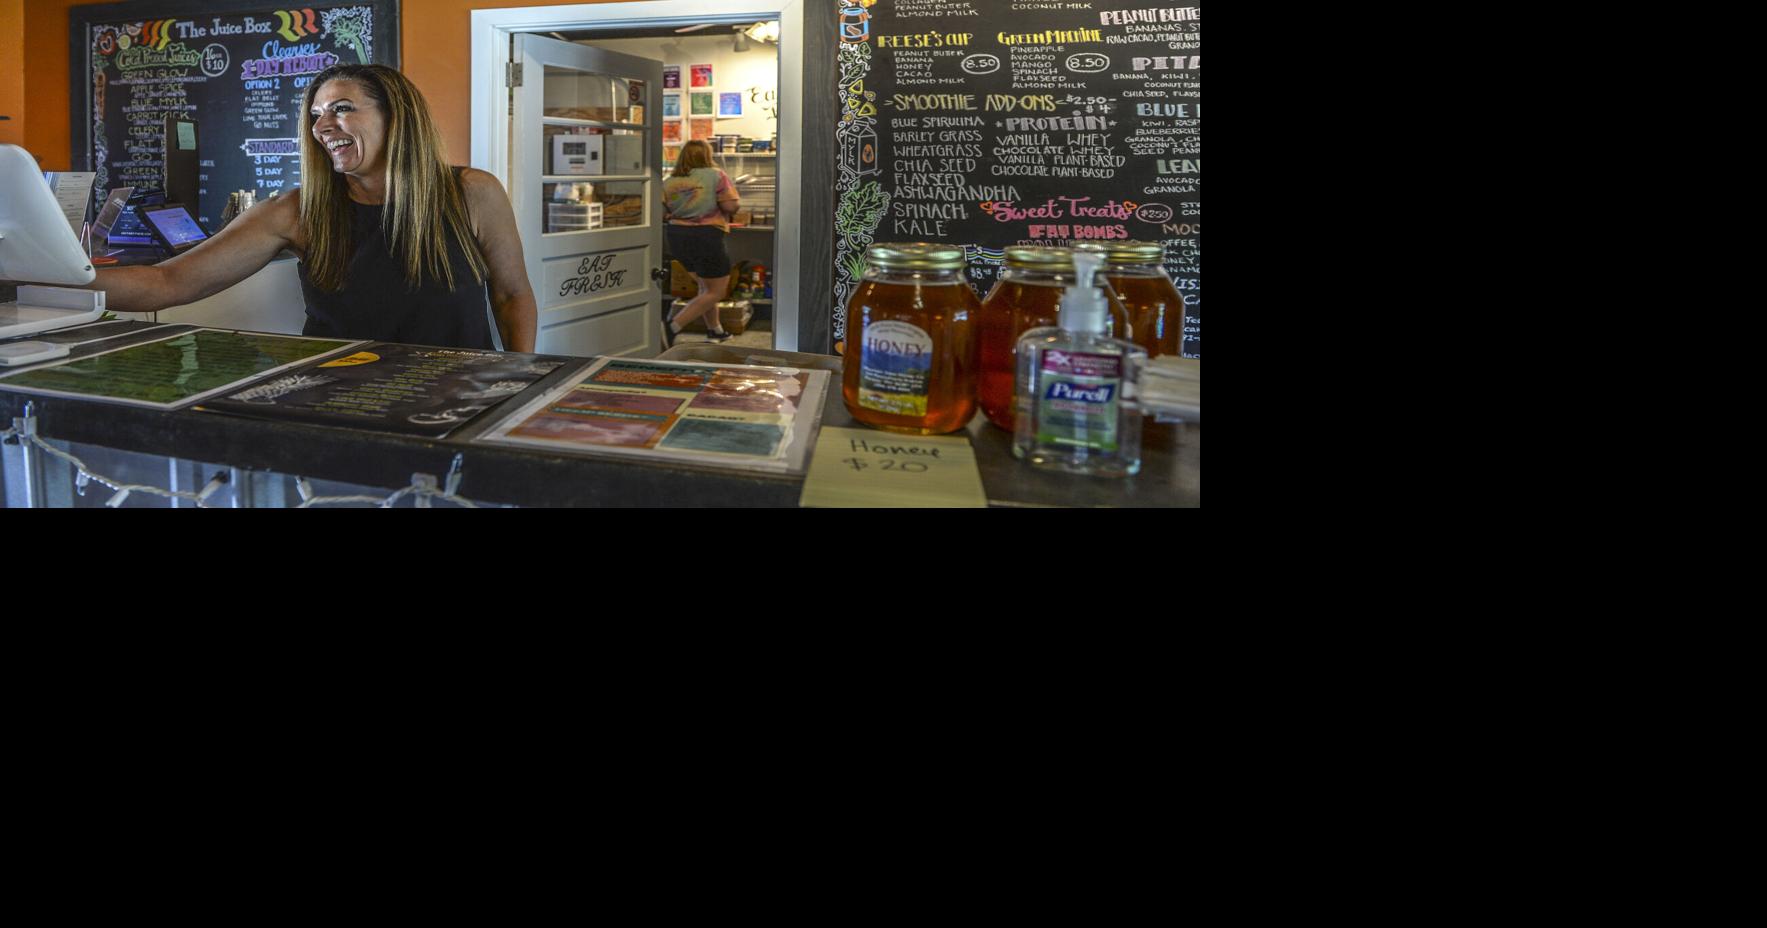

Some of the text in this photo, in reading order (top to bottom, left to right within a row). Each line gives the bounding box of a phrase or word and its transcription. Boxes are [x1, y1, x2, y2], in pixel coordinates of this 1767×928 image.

[895, 10, 944, 18] ALMOND
[1100, 8, 1158, 25] PEANUT
[175, 17, 272, 38] The Juice Box
[877, 30, 974, 48] REESE'S CUP
[1106, 34, 1127, 44] RAW
[262, 40, 320, 60] Cleanses
[965, 58, 996, 69] 8.50
[1069, 58, 1105, 69] 8.50
[121, 69, 188, 80] GREEN GLOW
[1012, 68, 1058, 76] SPINACH
[131, 83, 184, 93] APPLE SPICE
[244, 78, 280, 90] OPTION 2
[130, 97, 188, 107] BLUE MYLK
[893, 93, 978, 111] SMOOTHIE
[985, 94, 1057, 112] ADD-ONS
[126, 111, 158, 121] CARROT
[1136, 102, 1190, 118] BLUE
[891, 116, 985, 128] BLUE SPIRULINA
[128, 126, 160, 135] CELERY
[893, 130, 983, 143] BARLEY GRASS
[123, 139, 154, 150] FLAT
[996, 133, 1112, 147] VANILLA WHEY
[247, 141, 295, 154] STANDARD
[893, 143, 983, 158] WHEATGRASS
[993, 146, 1116, 156] CHOCOLATE WHEY
[1133, 147, 1166, 155] SEED
[131, 152, 153, 161] GO
[254, 154, 282, 165] 3 DAY
[998, 154, 1126, 168] VANILLA PLANT-BASED
[123, 166, 158, 175] GREEN
[255, 166, 283, 176] 5 DAY
[894, 158, 976, 173] CHIA SEED
[991, 164, 1050, 177] CHOCOLATE
[123, 180, 159, 189] IMMUNE
[256, 179, 285, 188] 7 DAY
[894, 172, 966, 187] FLAXSEED
[893, 184, 1022, 202] ASHWAGANDHA
[1143, 185, 1196, 195] GRANOLA
[893, 202, 967, 220] SPINACH
[992, 195, 1130, 222] Sweet Treats
[894, 220, 949, 237] KALE
[1028, 223, 1129, 239] FAT BOMBS
[577, 254, 617, 275] EAT
[559, 269, 628, 297] FRESH
[867, 337, 927, 357] HONEY
